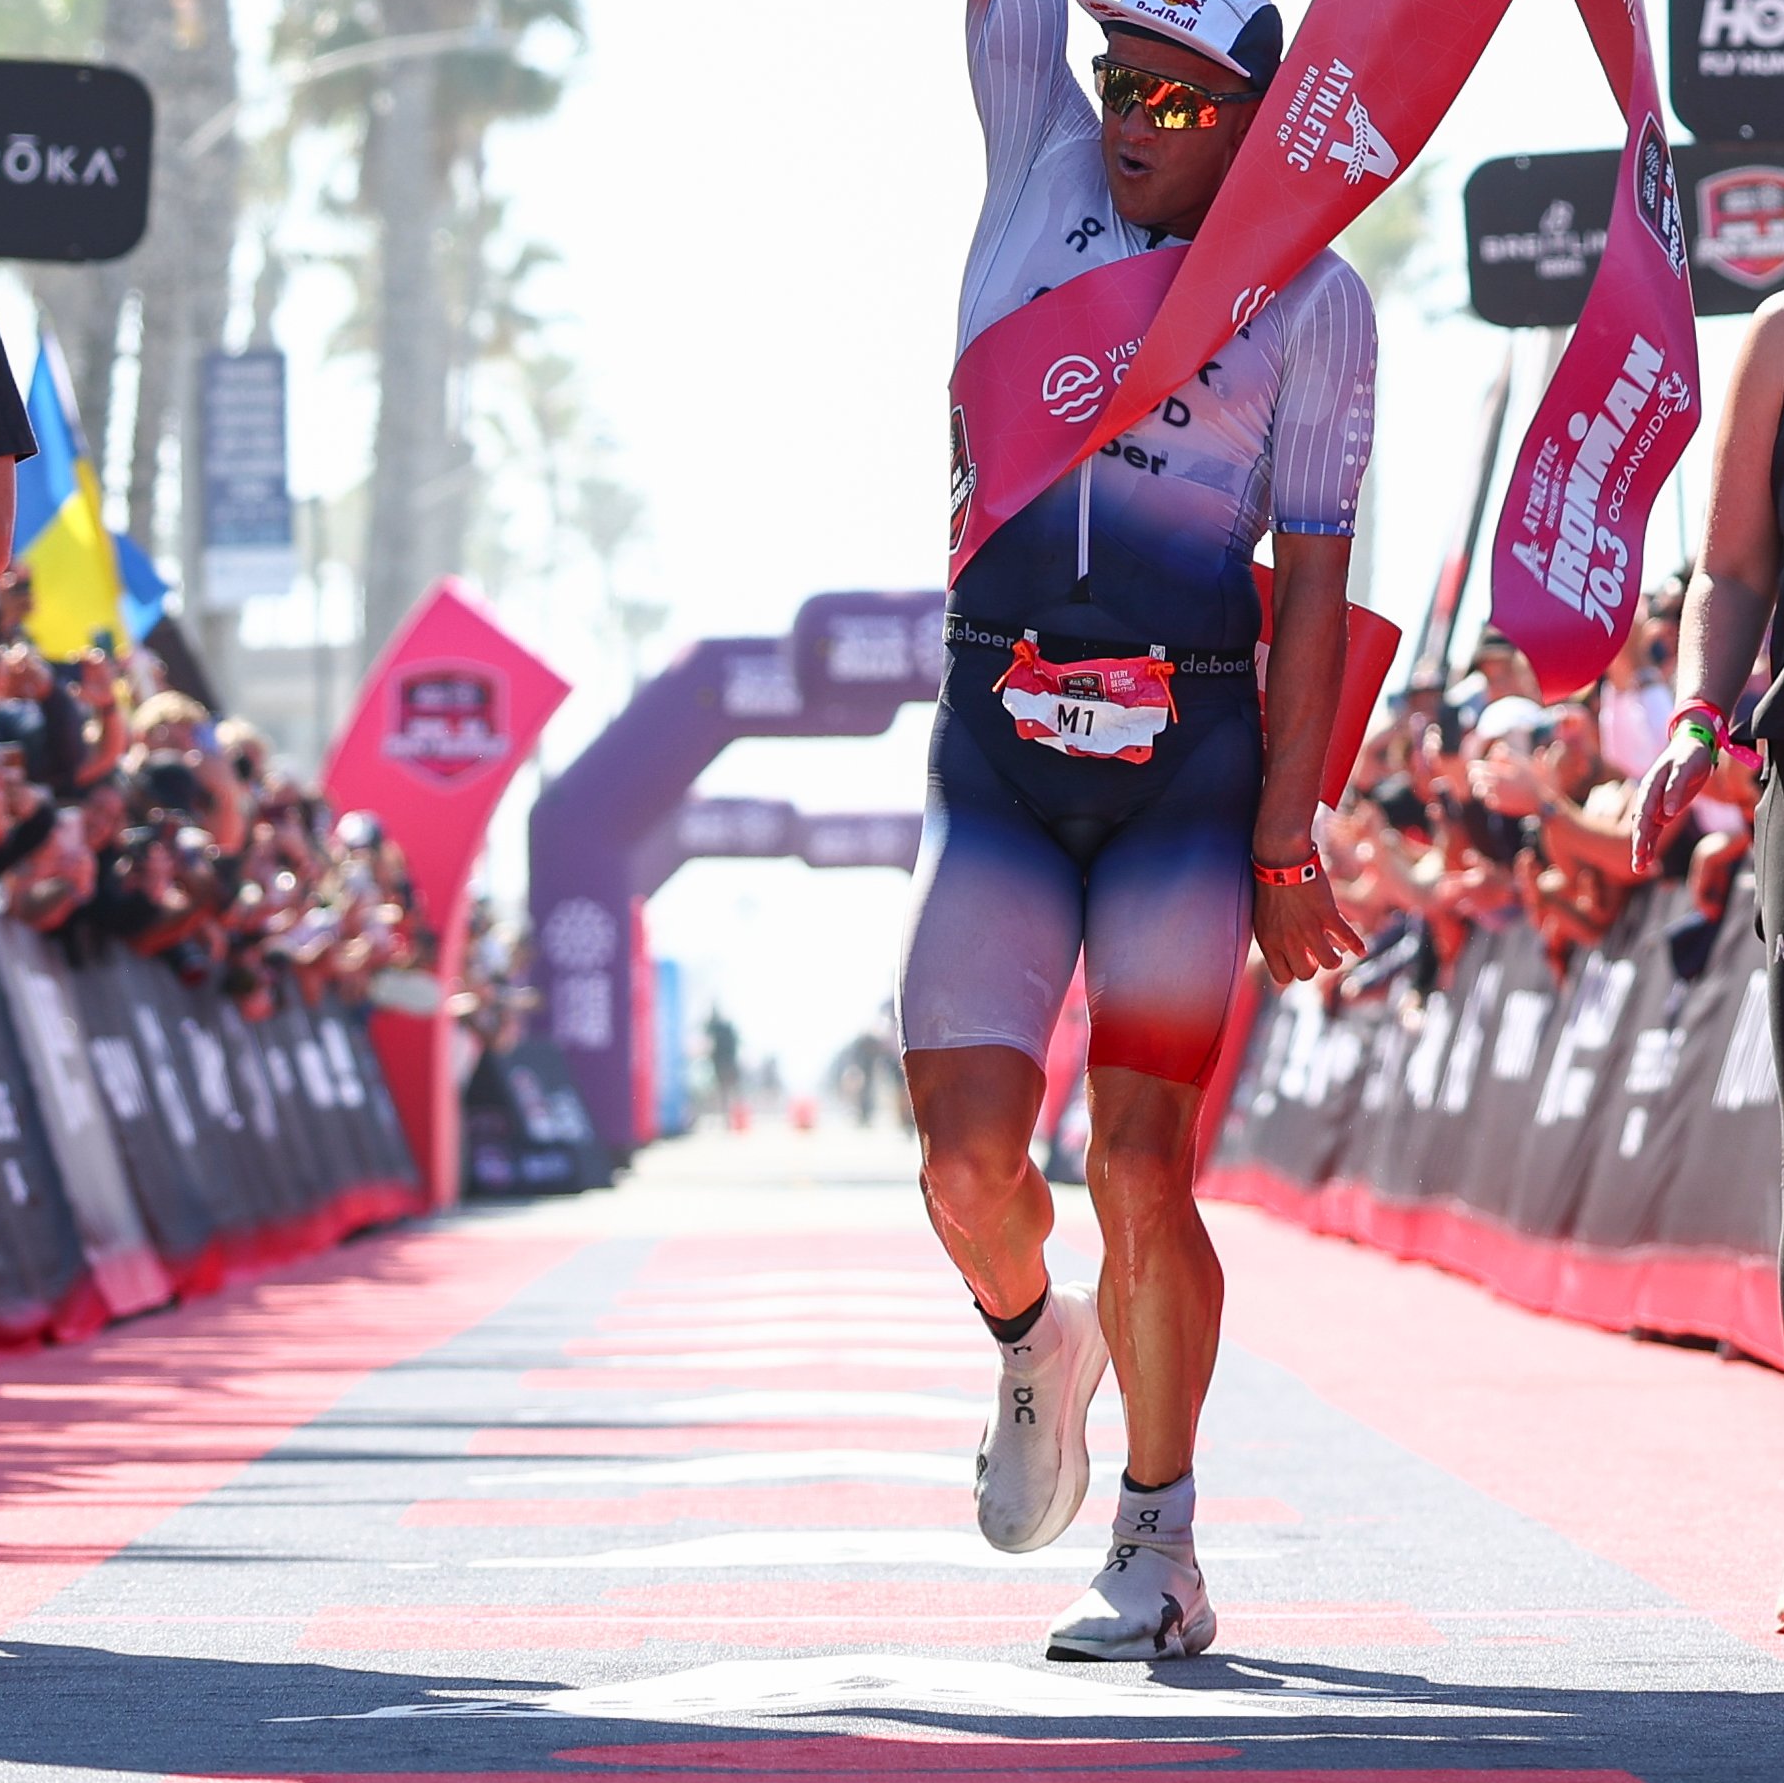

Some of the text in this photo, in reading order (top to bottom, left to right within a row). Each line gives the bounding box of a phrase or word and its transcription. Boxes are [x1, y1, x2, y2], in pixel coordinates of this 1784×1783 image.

[1286, 65, 1319, 123] BREWING
[1287, 58, 1354, 172] ATHLETIC
[1105, 336, 1146, 364] VISI
[1522, 436, 1560, 535] ATHLETIC
[1546, 333, 1664, 611] IRONMAN
[1608, 400, 1672, 523] OCEANSIDE
[951, 470, 974, 515] ERIES
[1584, 526, 1628, 638] 70.3
[947, 622, 1014, 650] deboer
[1180, 653, 1250, 675] deboer
[1058, 703, 1095, 736] M1
